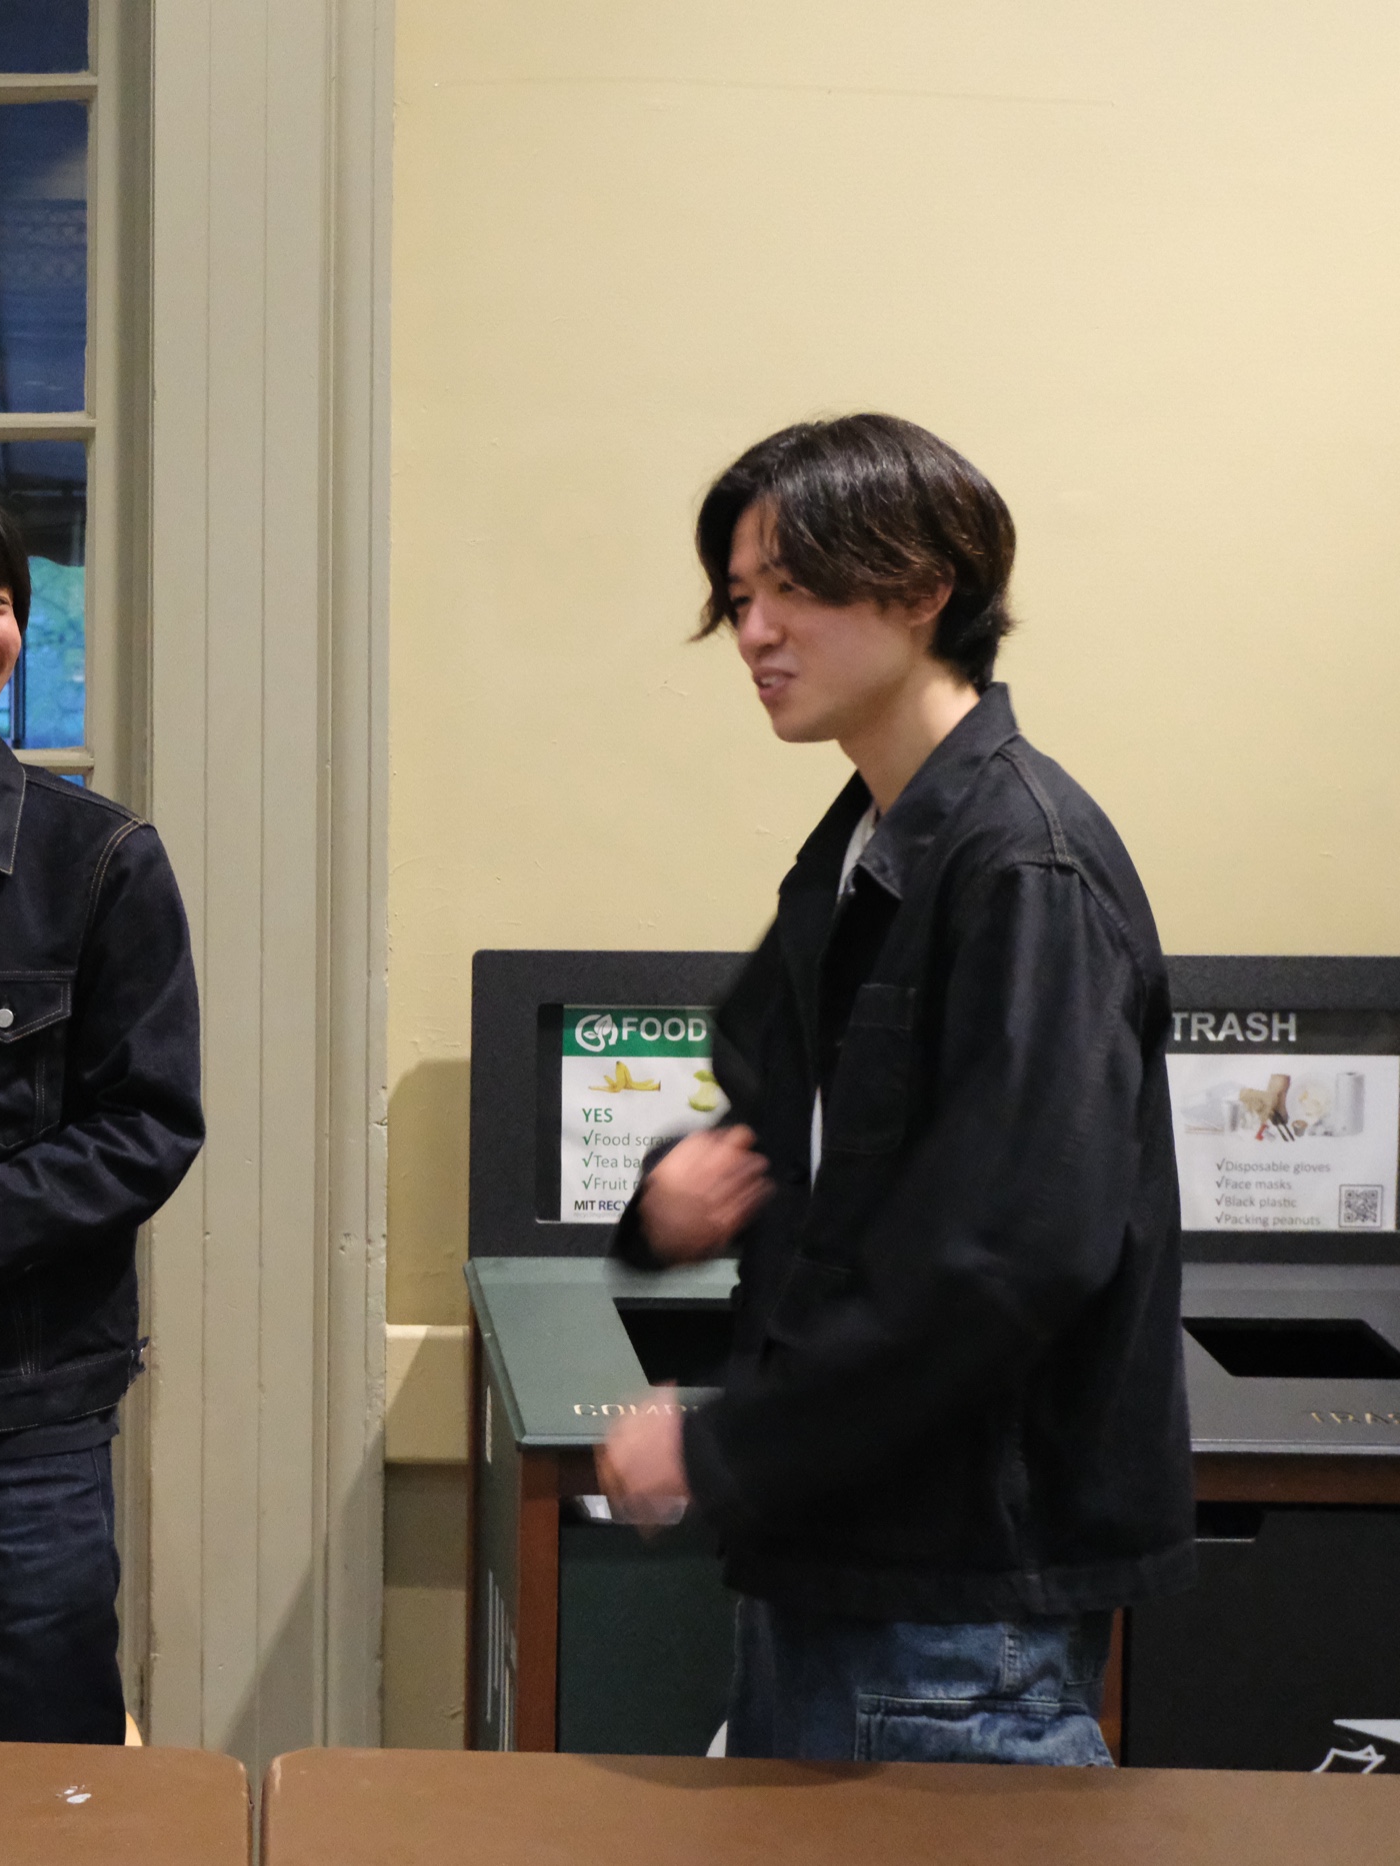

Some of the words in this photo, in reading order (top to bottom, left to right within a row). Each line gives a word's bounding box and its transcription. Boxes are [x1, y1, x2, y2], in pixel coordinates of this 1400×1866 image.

[622, 1016, 708, 1042] FOOD
[1172, 1011, 1298, 1042] TRASH
[582, 1107, 614, 1123] YES
[594, 1132, 630, 1146] Food
[594, 1155, 618, 1168] Tea
[1225, 1160, 1290, 1174] Disposable
[1292, 1160, 1331, 1175] gloves
[594, 1177, 628, 1190] Fruit
[1225, 1179, 1252, 1190] Face
[1255, 1179, 1292, 1190] masks
[574, 1200, 596, 1211] MIT
[1224, 1195, 1255, 1207] Black
[1259, 1196, 1297, 1208] plastic
[1224, 1213, 1269, 1227] Packing
[1272, 1215, 1321, 1226] peanuts
